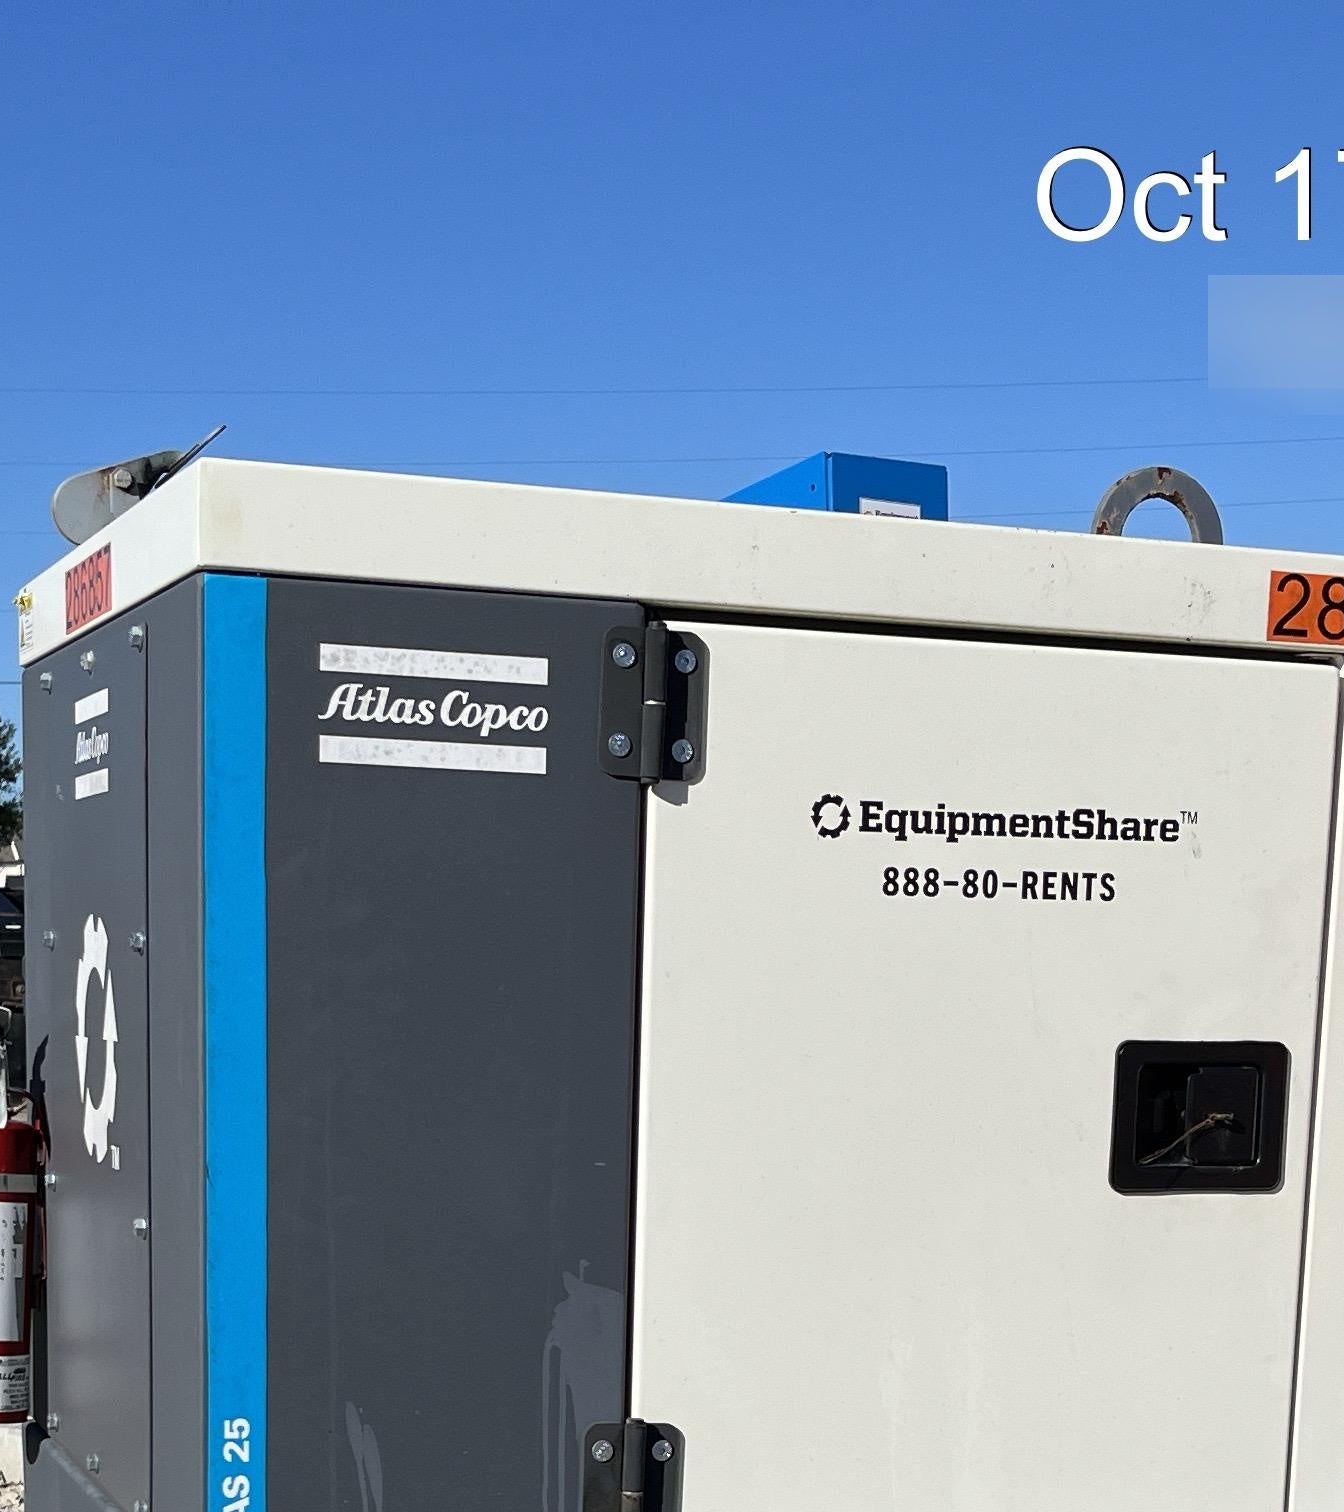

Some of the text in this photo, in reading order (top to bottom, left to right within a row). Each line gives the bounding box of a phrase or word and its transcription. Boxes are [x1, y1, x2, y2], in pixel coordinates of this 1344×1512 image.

[65, 542, 112, 630] 286857
[317, 682, 549, 738] Atlas Copco
[881, 866, 1117, 902] 888-80-RENTS
[222, 1416, 252, 1464] 25
